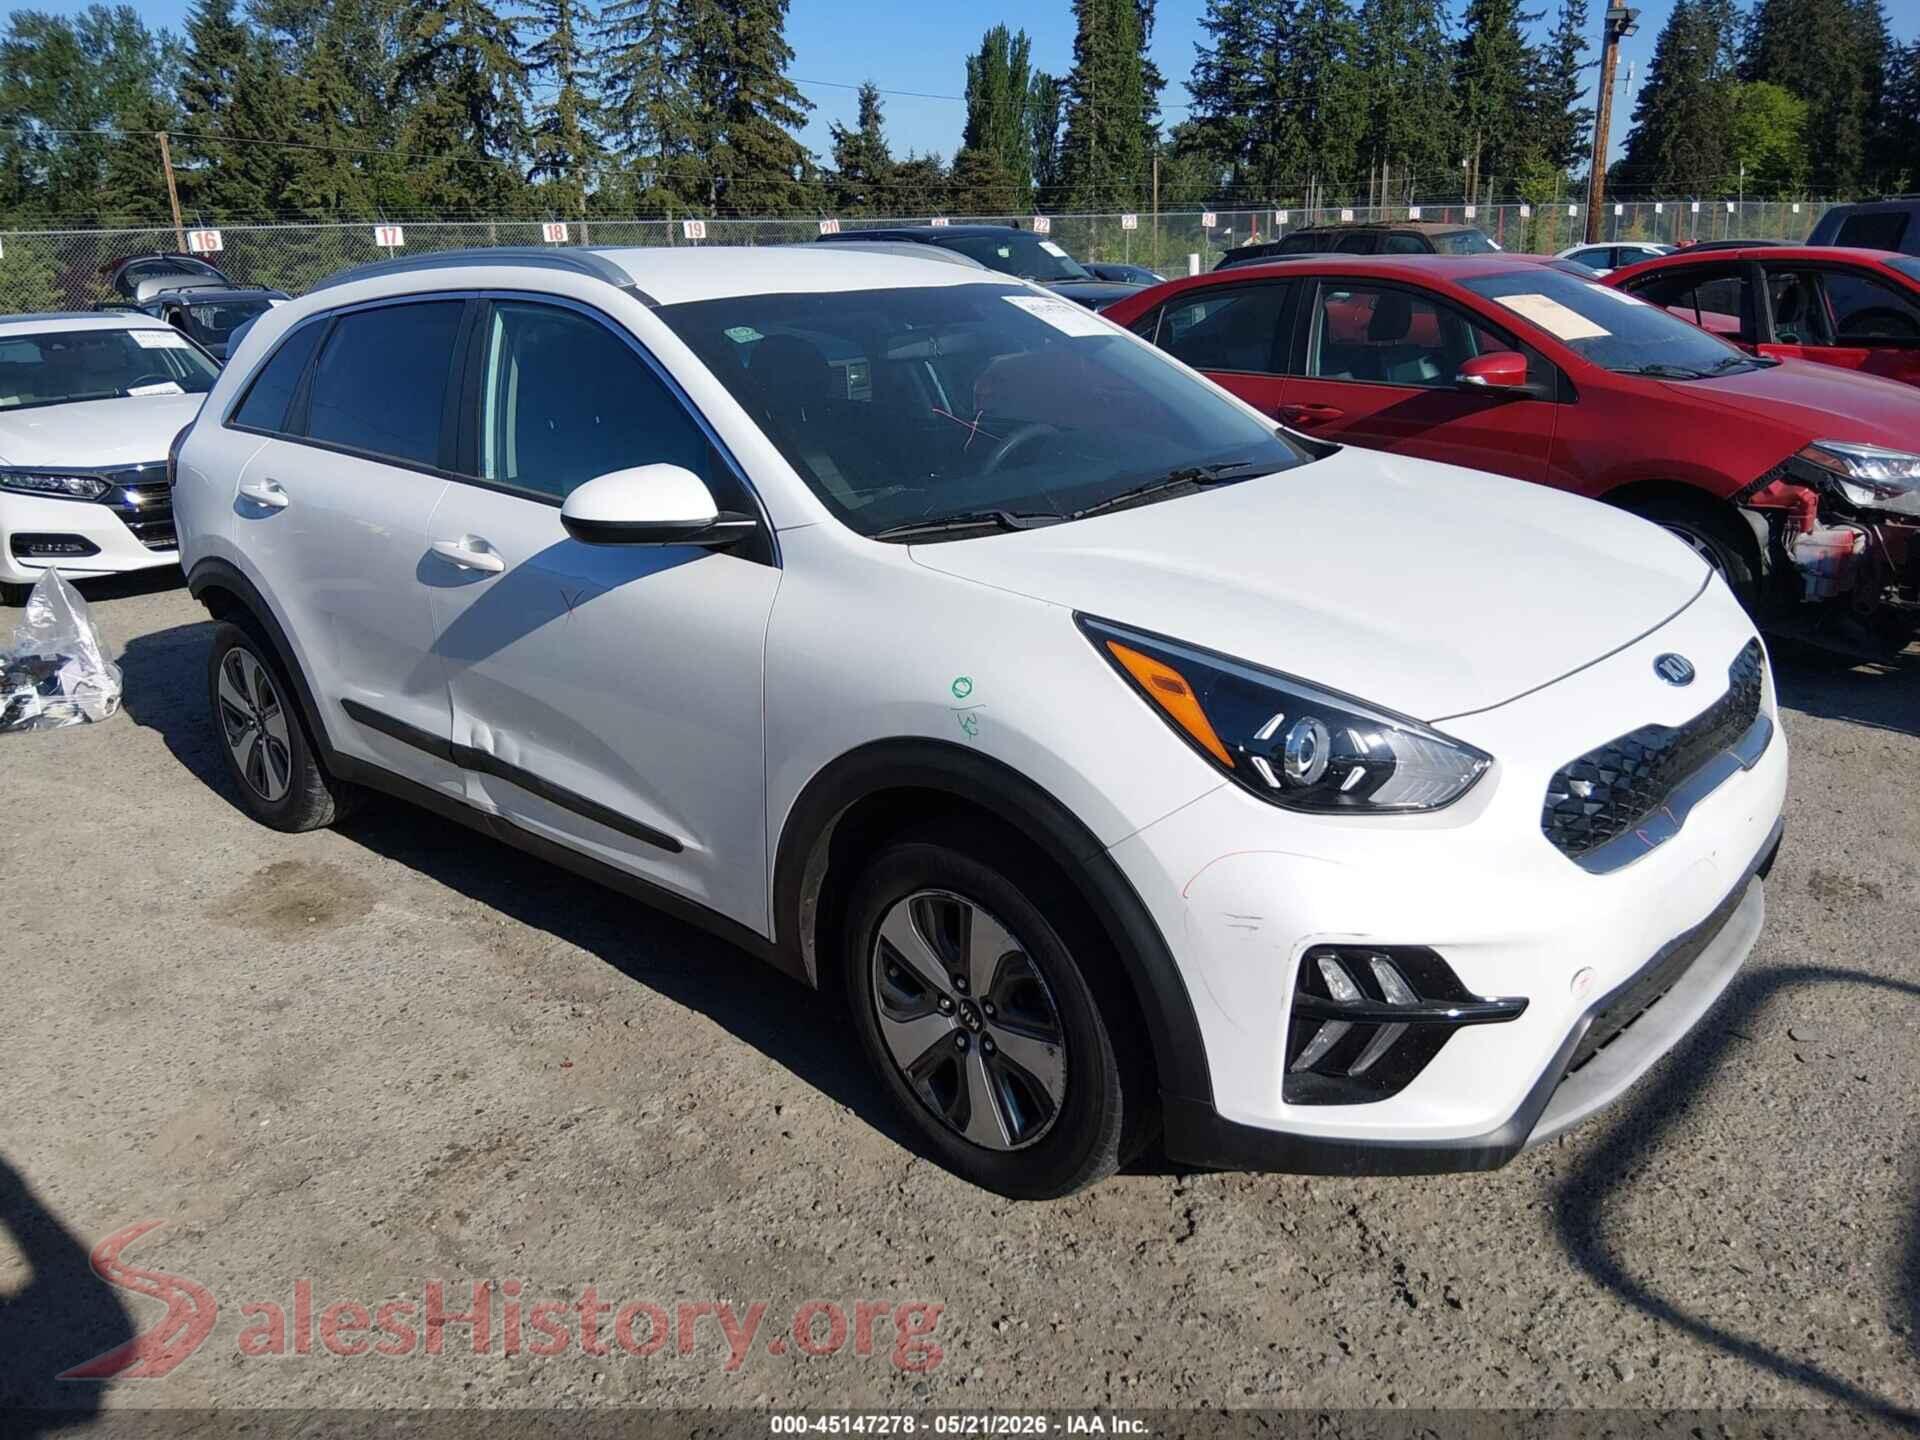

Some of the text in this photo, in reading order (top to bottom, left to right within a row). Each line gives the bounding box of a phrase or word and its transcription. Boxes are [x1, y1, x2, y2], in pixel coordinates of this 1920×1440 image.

[687, 222, 703, 238] 19
[1035, 218, 1049, 231] 22
[194, 231, 217, 250] 16
[381, 227, 398, 245] 17
[547, 225, 564, 241] 18
